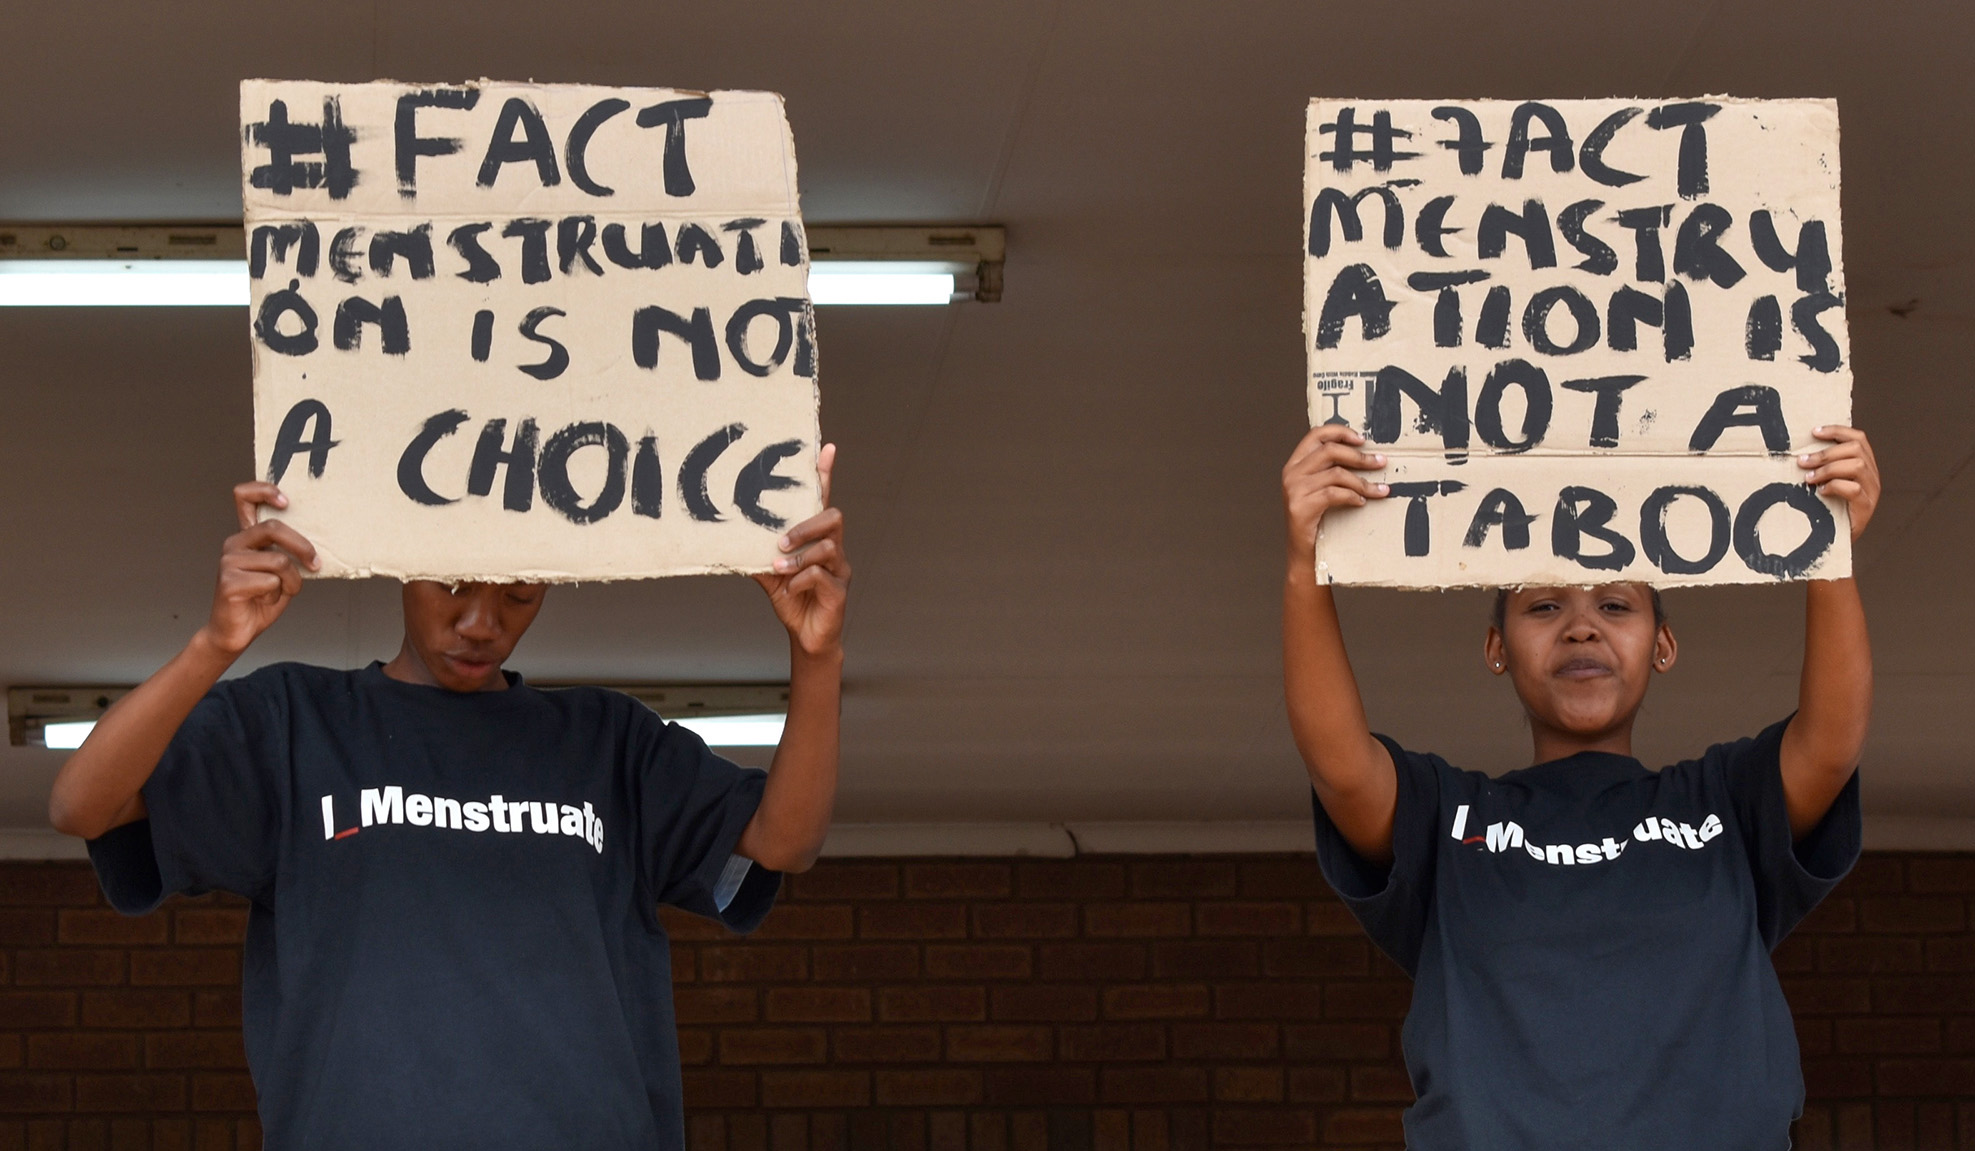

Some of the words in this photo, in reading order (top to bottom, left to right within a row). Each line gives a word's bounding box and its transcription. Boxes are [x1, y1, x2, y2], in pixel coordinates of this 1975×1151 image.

[245, 88, 714, 200] #FACT
[472, 306, 570, 380] IS
[1316, 264, 1695, 362] ATION
[1745, 292, 1846, 373] IS
[269, 399, 341, 484] A
[397, 409, 807, 532] CHOICE
[1370, 359, 1648, 465] NOT
[1689, 386, 1791, 457] A
[1388, 480, 1836, 580] TABOO
